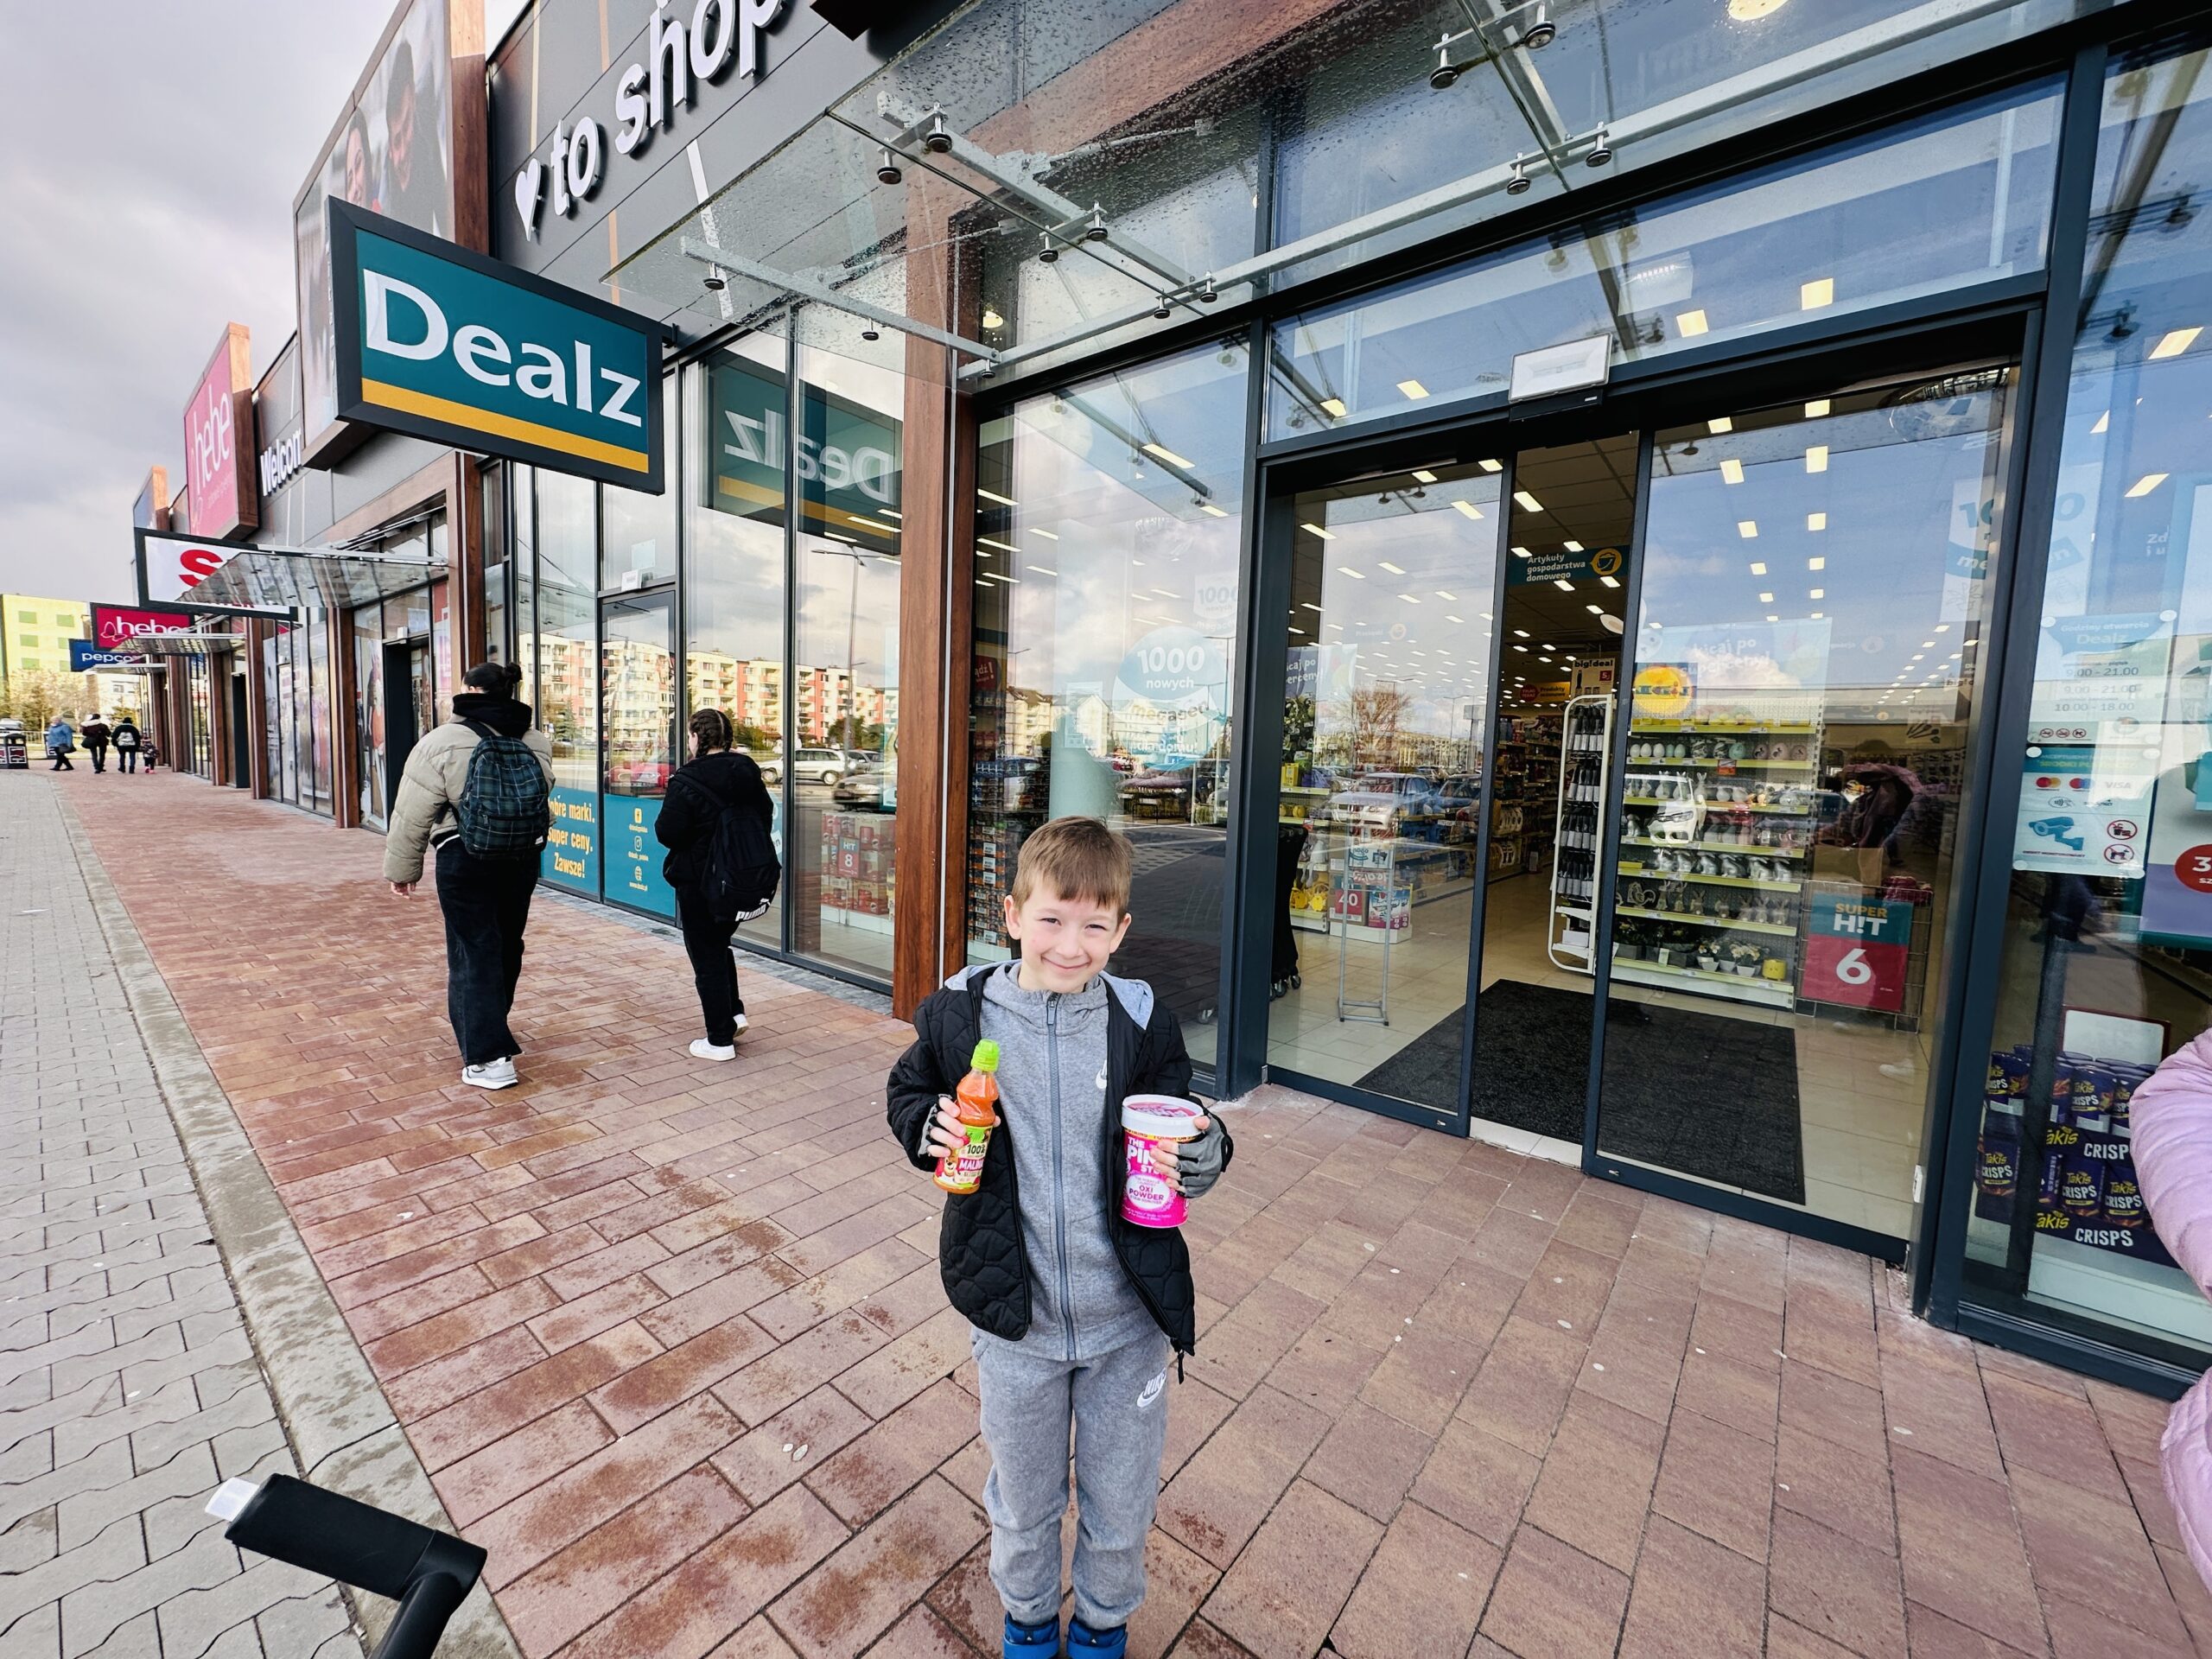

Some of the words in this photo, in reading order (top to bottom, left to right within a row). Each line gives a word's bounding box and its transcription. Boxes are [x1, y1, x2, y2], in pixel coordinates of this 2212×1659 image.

[553, 119, 601, 216] to
[615, 0, 779, 155] shop
[362, 269, 642, 427] Dealz
[194, 384, 230, 496] hebe
[1528, 553, 1565, 564] Artykuły
[1527, 561, 1586, 575] gospodarstwa
[1526, 572, 1571, 582] domowego
[2076, 632, 2128, 645] Dealz
[1737, 638, 1757, 656] po
[82, 652, 133, 664] pepco
[1137, 645, 1205, 674] 1000
[2103, 666, 2139, 677] 21.00
[1147, 677, 1194, 690] nowych
[2101, 702, 2135, 711] 18.00
[2105, 781, 2132, 790] VISA
[569, 802, 595, 823] marki.
[554, 852, 586, 879] Zawsze!
[844, 854, 854, 868] 8
[1835, 903, 1888, 918] SUPER
[1836, 948, 1872, 985] 6
[1128, 1136, 1146, 1149] THE
[2047, 1127, 2078, 1145] akis
[1127, 1144, 1156, 1166] PIN
[2083, 1142, 2130, 1160] CRISP
[2067, 1172, 2092, 1185] Takis
[1129, 1187, 1164, 1200] POWDER
[2062, 1185, 2098, 1199] CRISPS
[2109, 1181, 2137, 1194] Takis
[2105, 1194, 2143, 1210] CRISPS
[2037, 1212, 2069, 1229] akis
[2075, 1227, 2134, 1247] CRISPS
